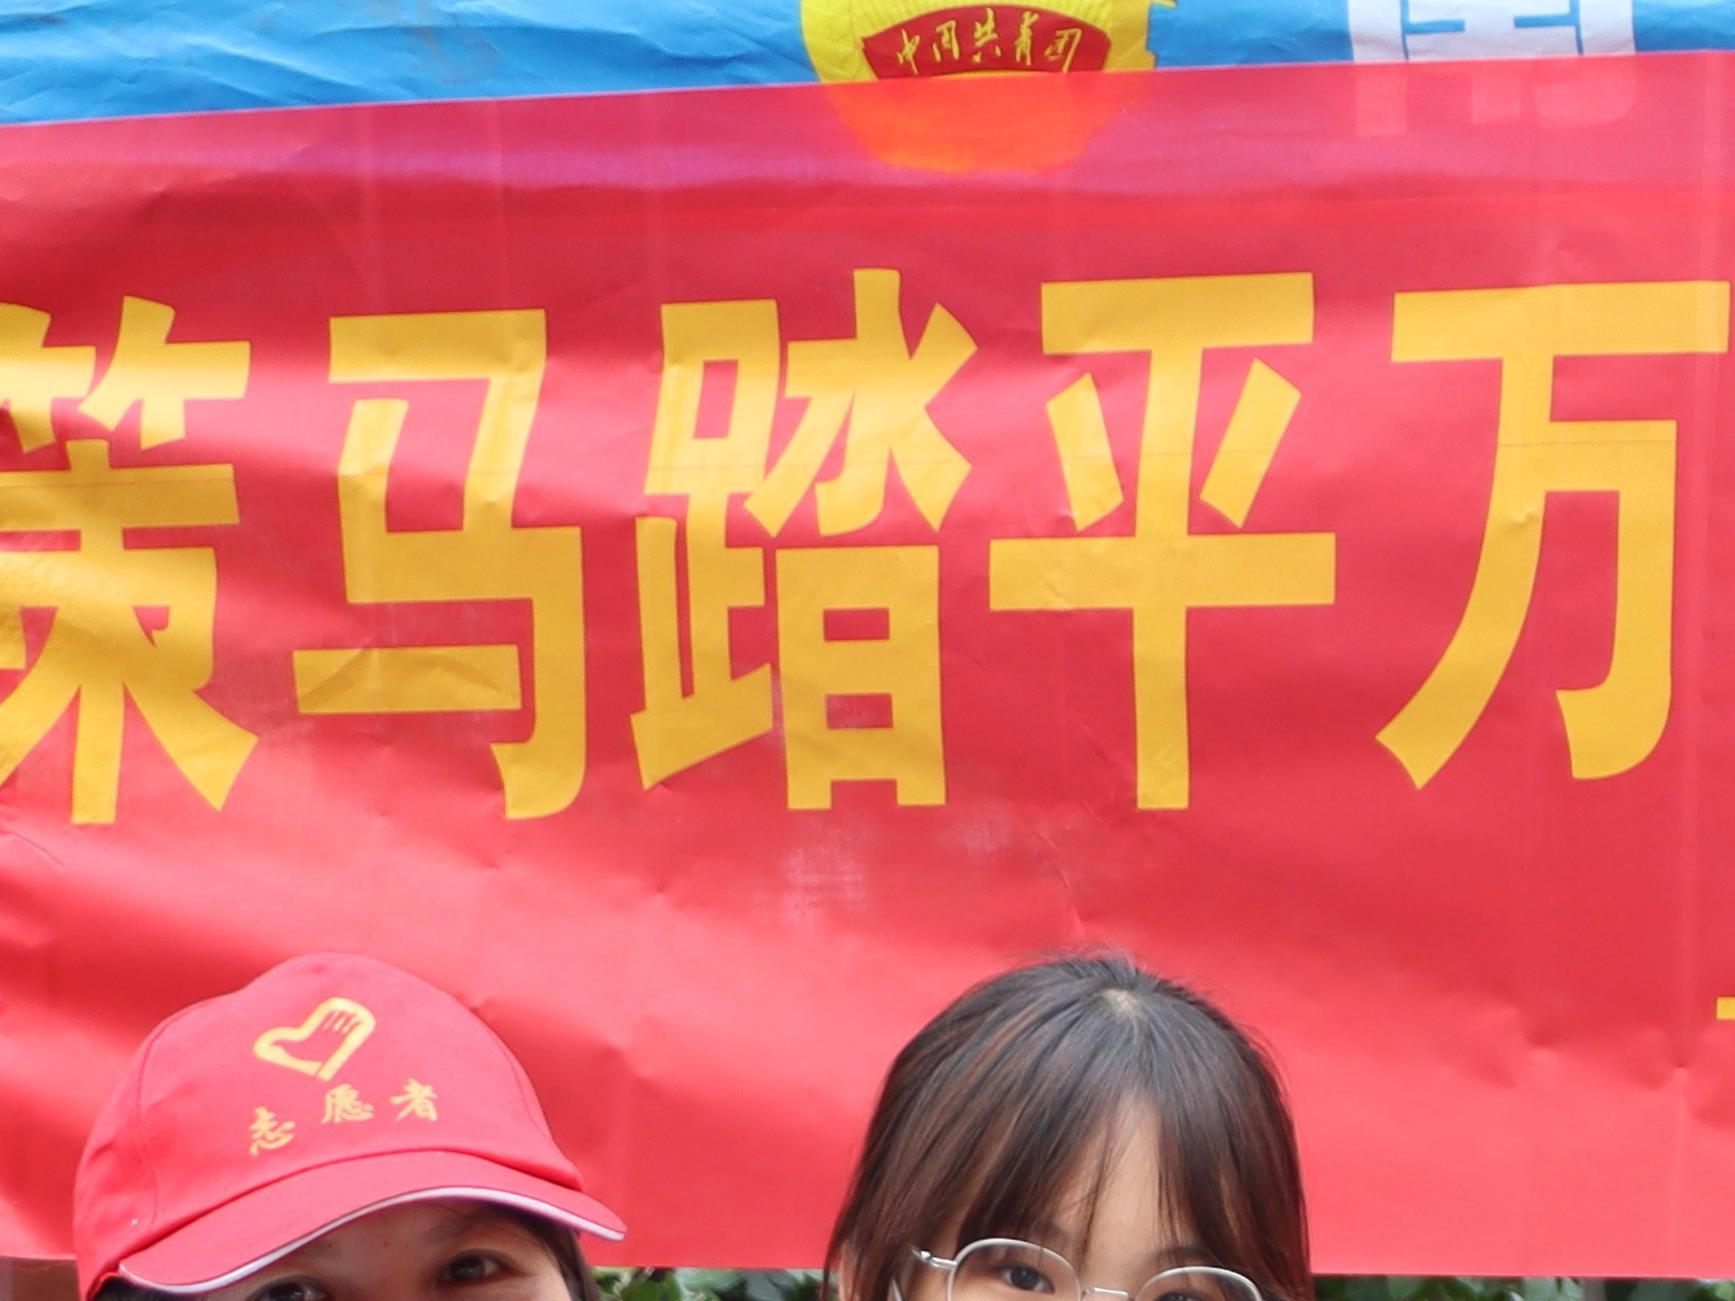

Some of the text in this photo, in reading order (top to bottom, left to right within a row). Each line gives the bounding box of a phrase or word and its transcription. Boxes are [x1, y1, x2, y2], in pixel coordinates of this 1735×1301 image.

[894, 8, 1083, 75] 中国共青团
[248, 1077, 439, 1156] 志愿者
